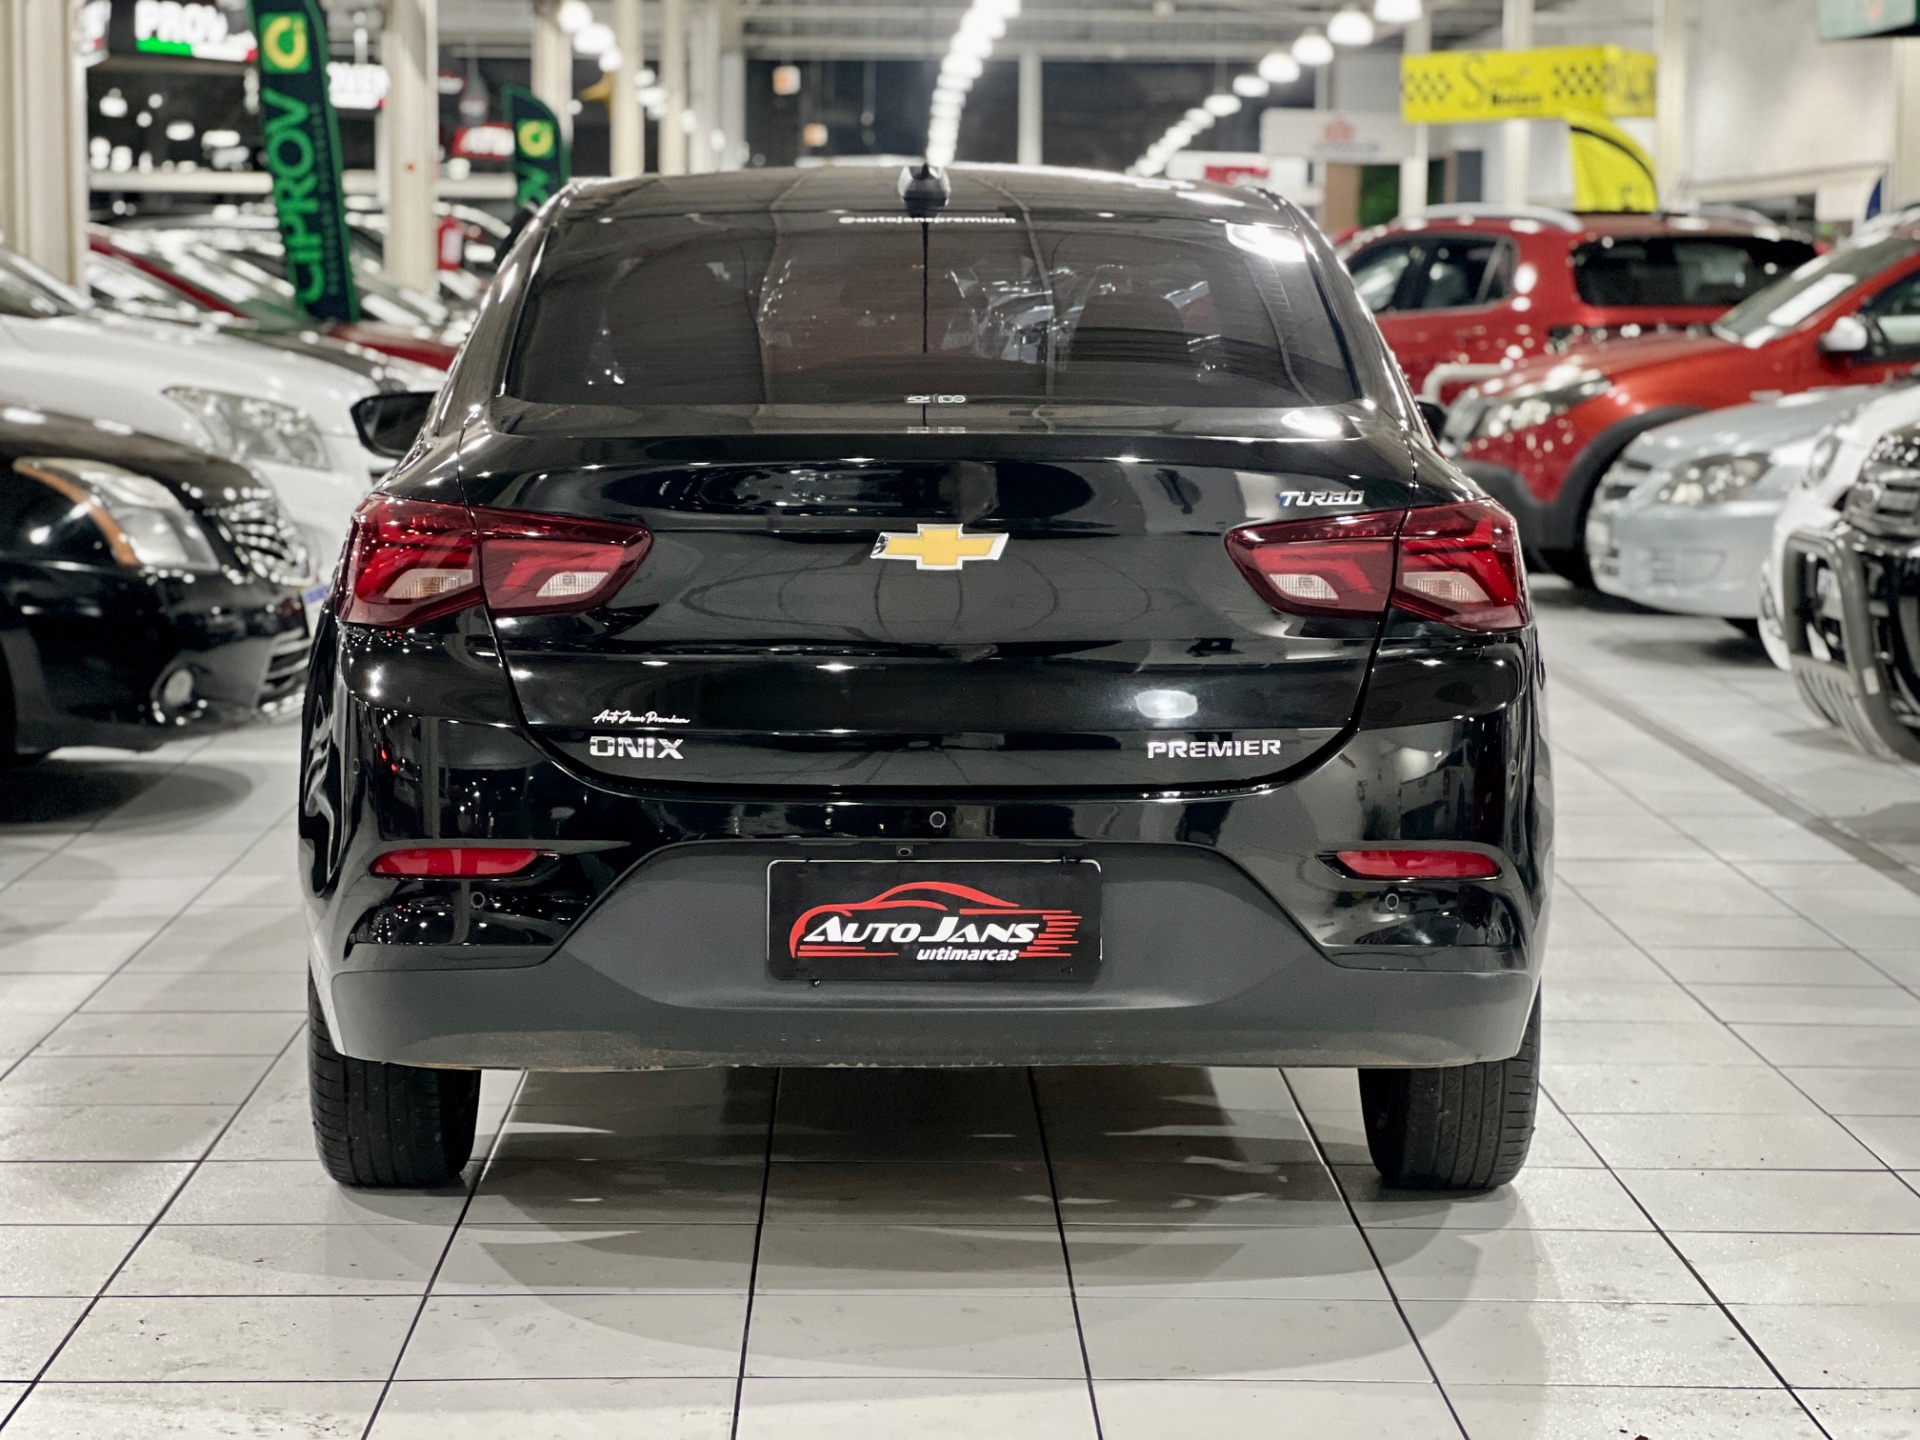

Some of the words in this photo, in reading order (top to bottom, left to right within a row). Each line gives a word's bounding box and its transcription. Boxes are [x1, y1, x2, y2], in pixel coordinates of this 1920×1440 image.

[1275, 489, 1365, 509] TURBO
[589, 735, 684, 760] ONIX
[1147, 739, 1281, 759] PREMIER
[803, 916, 921, 943] AUTO
[917, 916, 1040, 943] JANS
